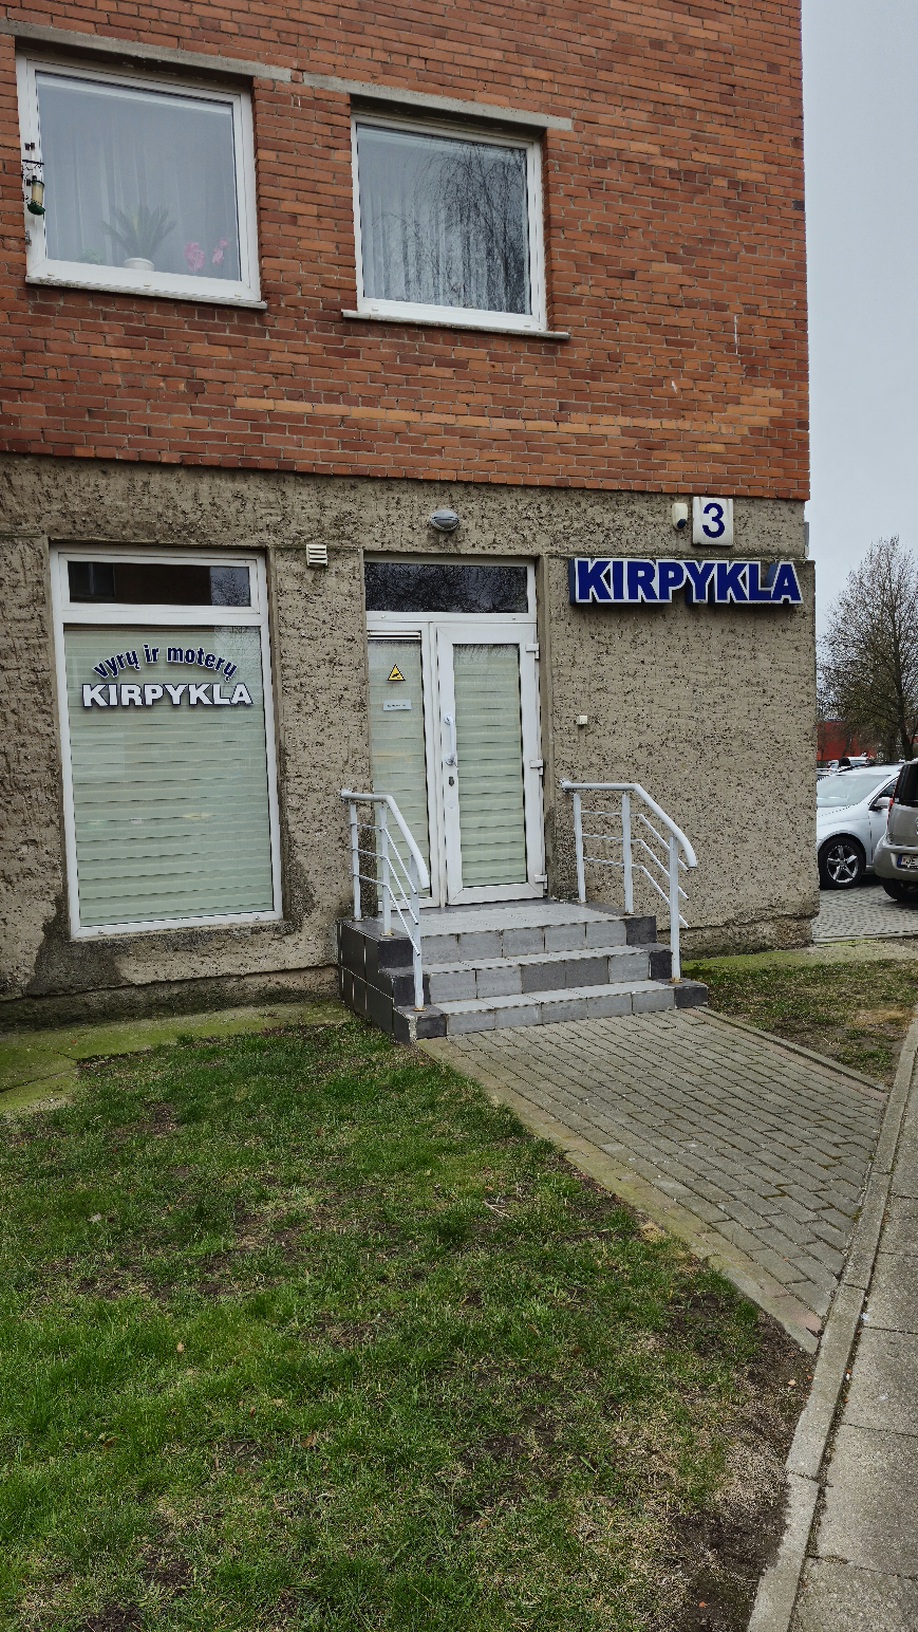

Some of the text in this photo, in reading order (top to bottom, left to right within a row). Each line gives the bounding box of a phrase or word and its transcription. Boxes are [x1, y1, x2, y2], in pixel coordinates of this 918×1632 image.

[702, 502, 725, 538] 3
[574, 558, 803, 604] KIRPYKLA
[93, 644, 238, 682] vyrų ir moterų
[81, 683, 254, 707] KIRPYKLA
